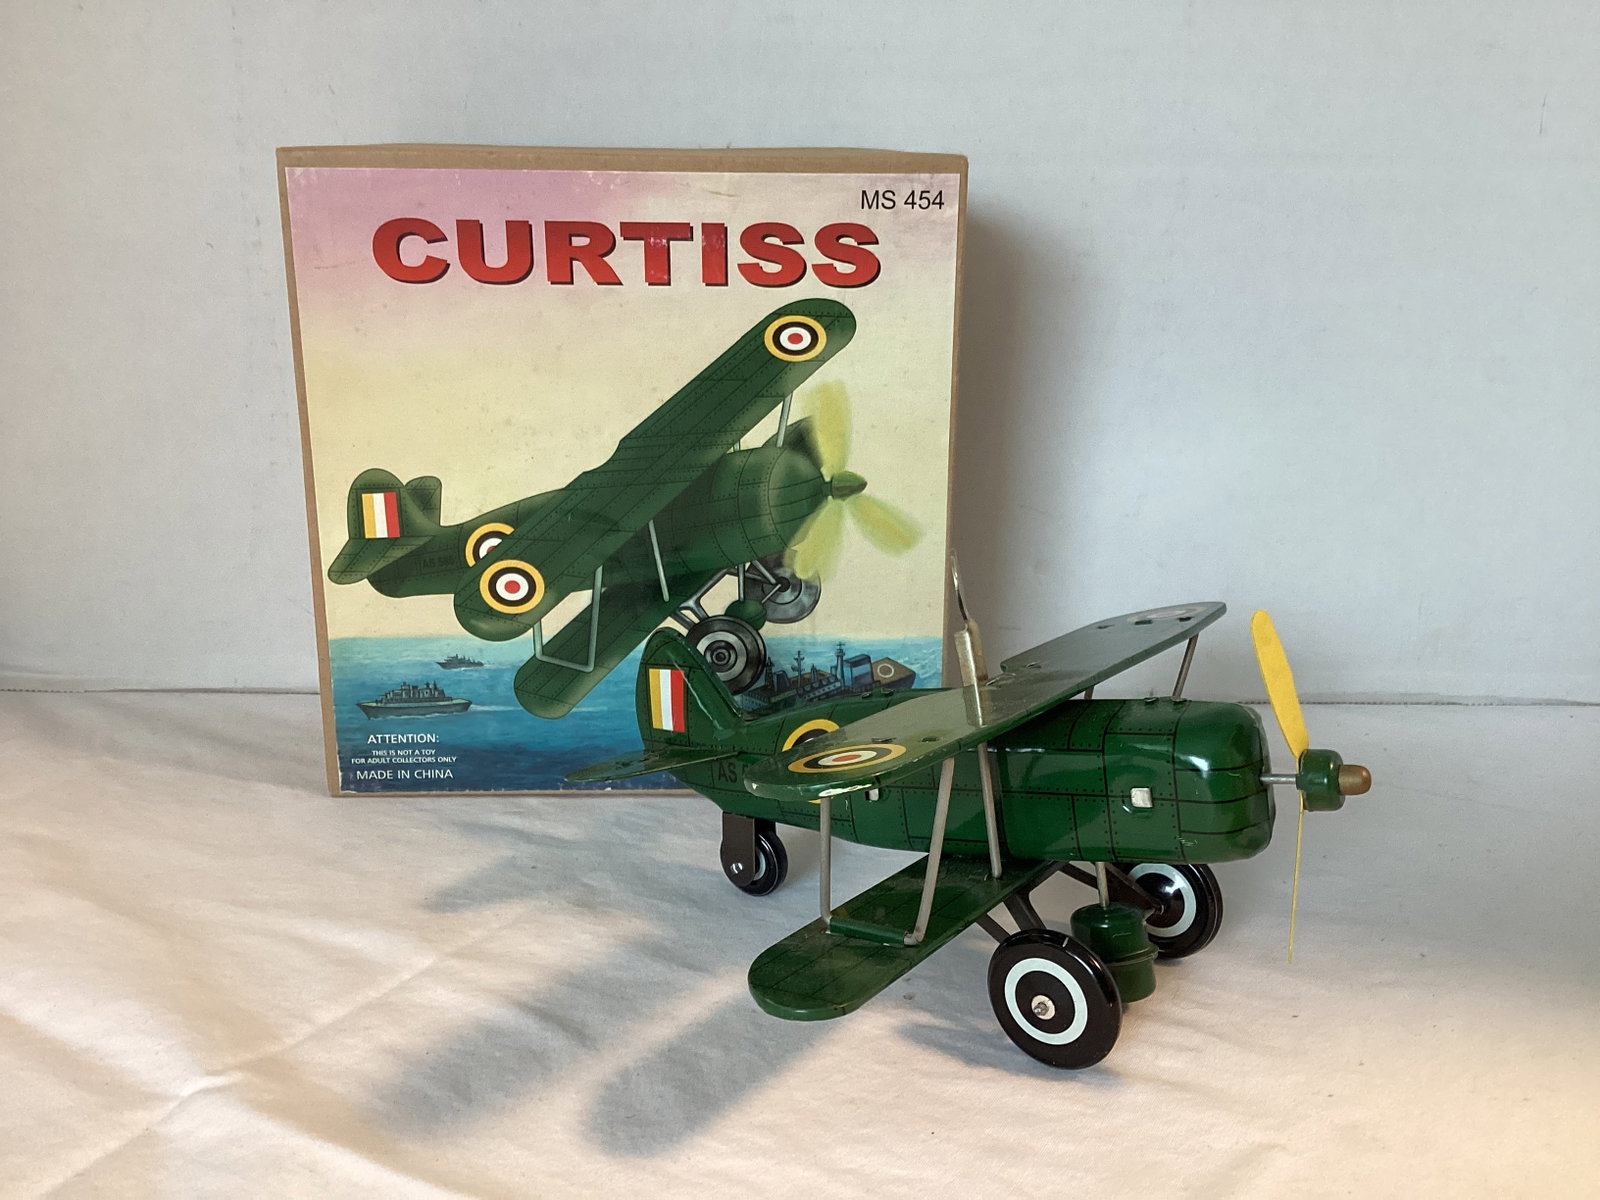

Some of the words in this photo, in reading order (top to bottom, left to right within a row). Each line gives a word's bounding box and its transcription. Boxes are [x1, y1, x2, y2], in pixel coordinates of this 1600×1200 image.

[860, 189, 896, 210] MS
[903, 189, 945, 210] 454
[372, 217, 882, 288] CURTISS
[367, 733, 440, 744] ATTENTION:
[356, 769, 394, 780] MADE
[397, 769, 410, 779] IN
[414, 769, 454, 779] CHINA
[718, 760, 738, 783] AS
